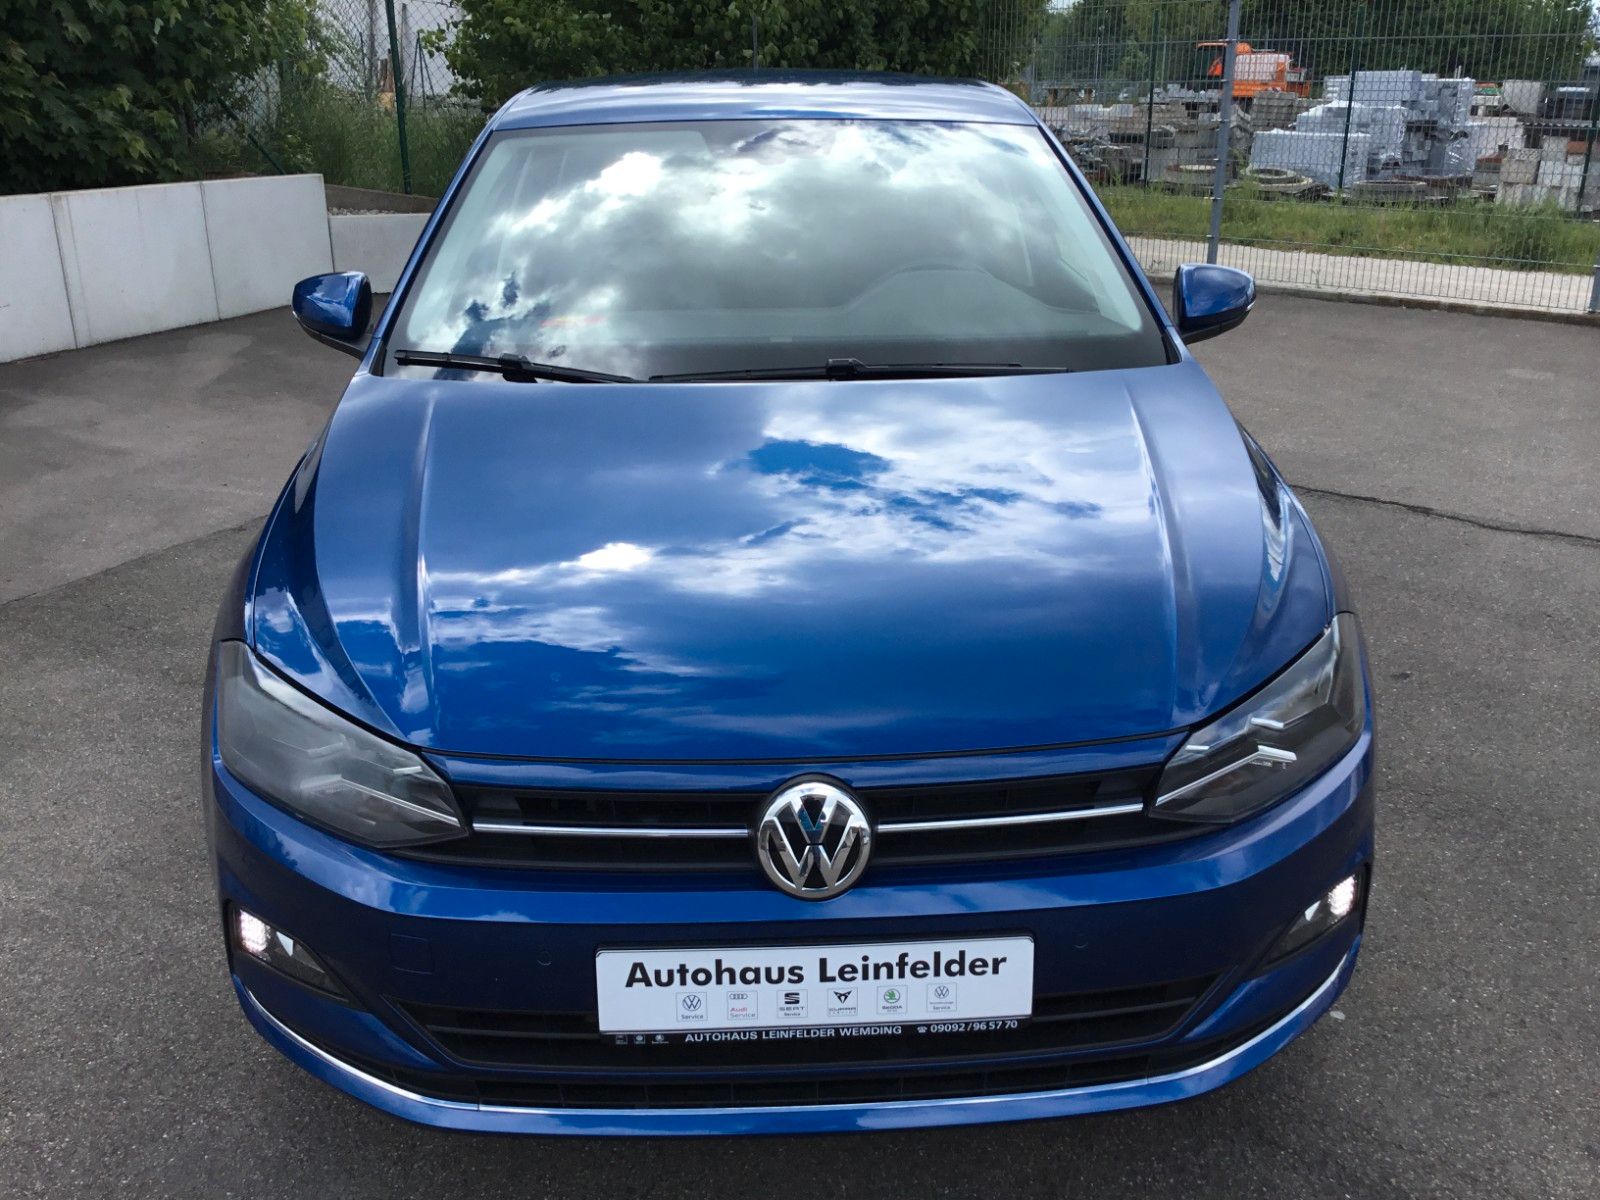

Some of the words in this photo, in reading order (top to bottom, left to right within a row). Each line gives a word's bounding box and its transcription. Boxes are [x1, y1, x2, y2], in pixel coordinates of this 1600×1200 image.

[625, 959, 805, 988] Autohaus
[819, 950, 1007, 983] Leinfelder
[685, 1031, 758, 1042] AUTOHAUS
[762, 1028, 835, 1039] LEINFELDER
[839, 1026, 902, 1036] WEMDING
